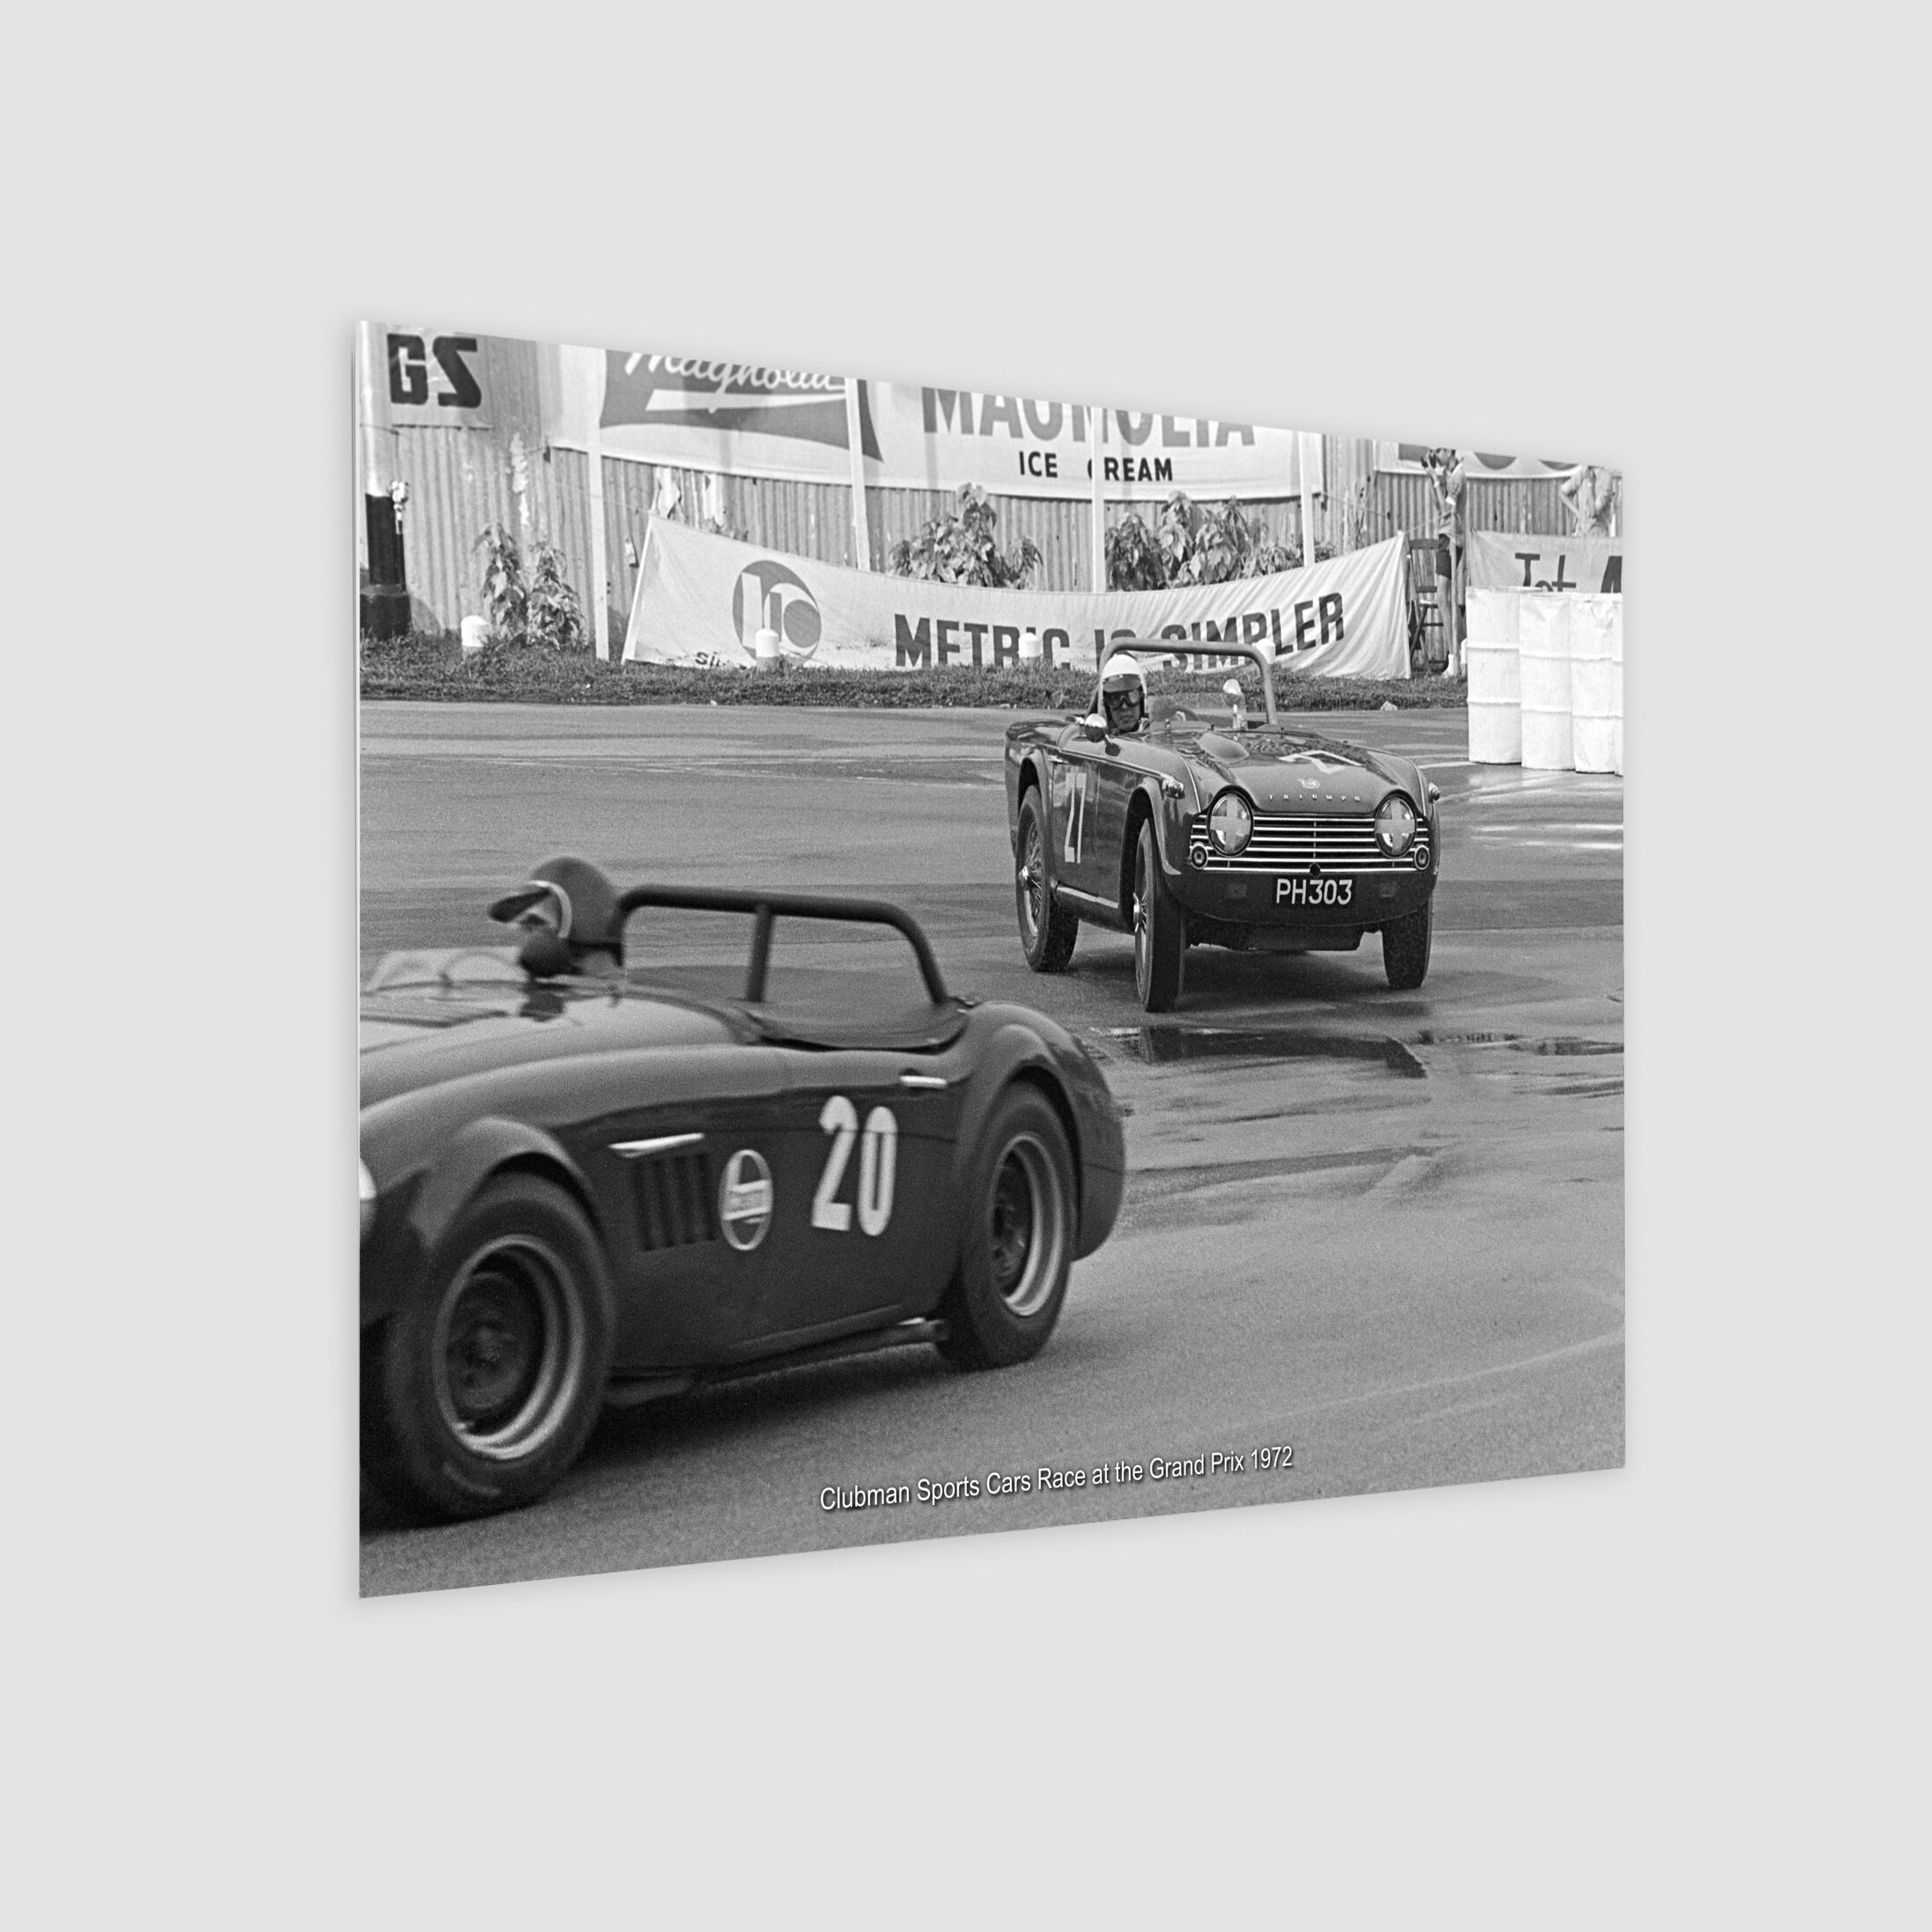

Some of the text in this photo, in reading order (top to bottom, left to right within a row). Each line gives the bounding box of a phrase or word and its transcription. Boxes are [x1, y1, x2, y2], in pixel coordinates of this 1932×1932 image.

[387, 333, 482, 409] GS
[1019, 451, 1173, 482] ICE REAM
[895, 614, 1070, 671] METRC
[1276, 878, 1353, 905] PH303
[812, 1095, 897, 1235] 20
